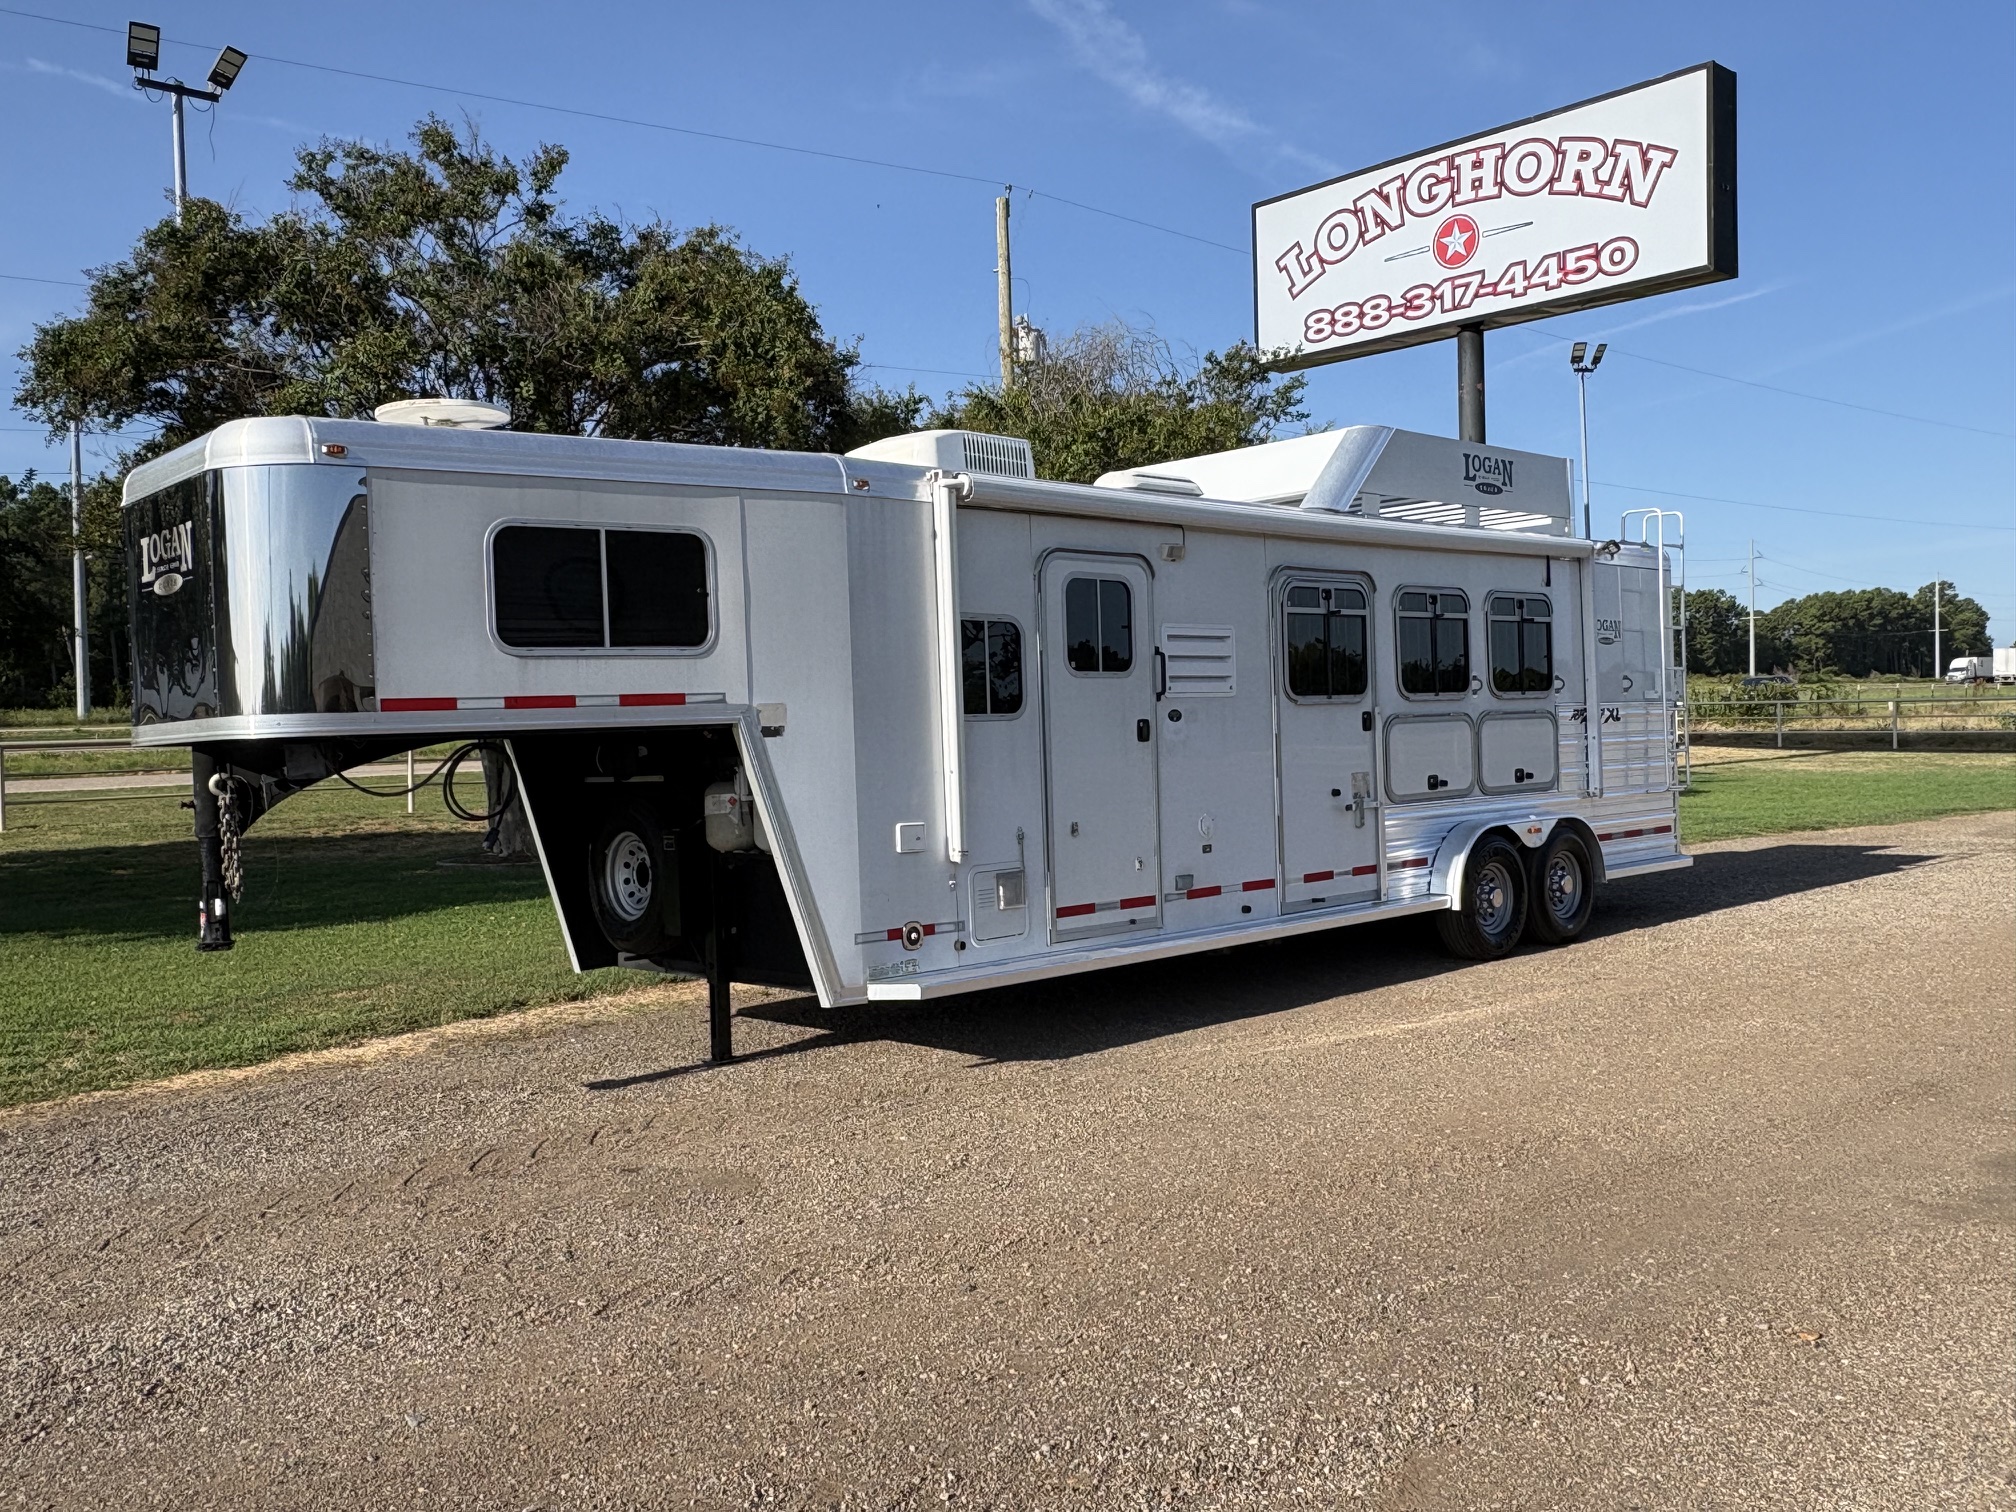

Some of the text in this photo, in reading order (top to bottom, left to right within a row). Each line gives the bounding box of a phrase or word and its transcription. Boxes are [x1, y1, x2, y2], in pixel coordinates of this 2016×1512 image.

[1276, 136, 1678, 299] LONGHORN
[1304, 236, 1639, 343] 888-317-4450
[1463, 453, 1513, 487] LOGAN
[140, 520, 192, 583] LOGAN
[1596, 619, 1621, 639] OGAN
